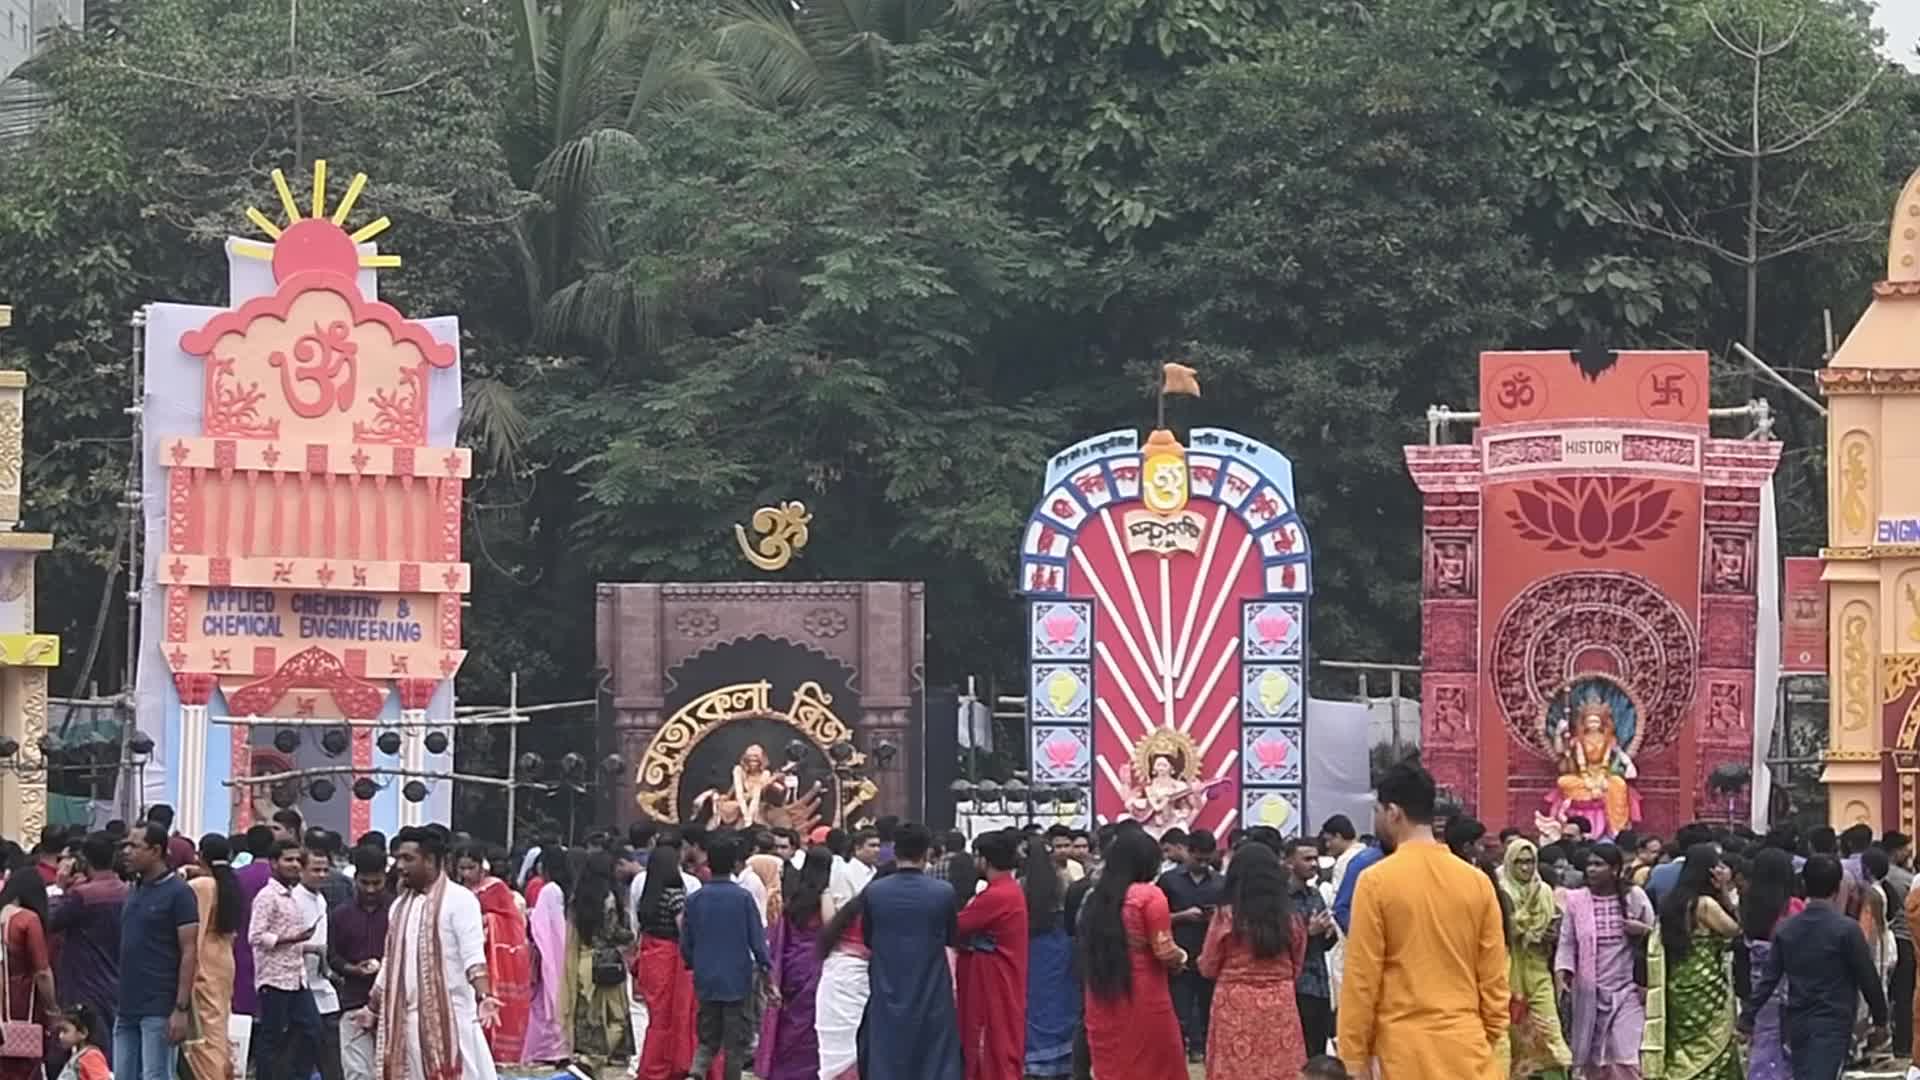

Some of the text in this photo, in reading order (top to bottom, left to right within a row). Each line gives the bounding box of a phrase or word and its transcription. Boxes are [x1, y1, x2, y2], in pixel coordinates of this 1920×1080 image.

[1565, 440, 1621, 455] HISTORY
[207, 591, 275, 613] APPLIED
[291, 593, 382, 617] CHEMISTRY
[203, 615, 422, 643] CHEMICAL ENGINEERING
[636, 679, 773, 786] নৃত্যকলা
